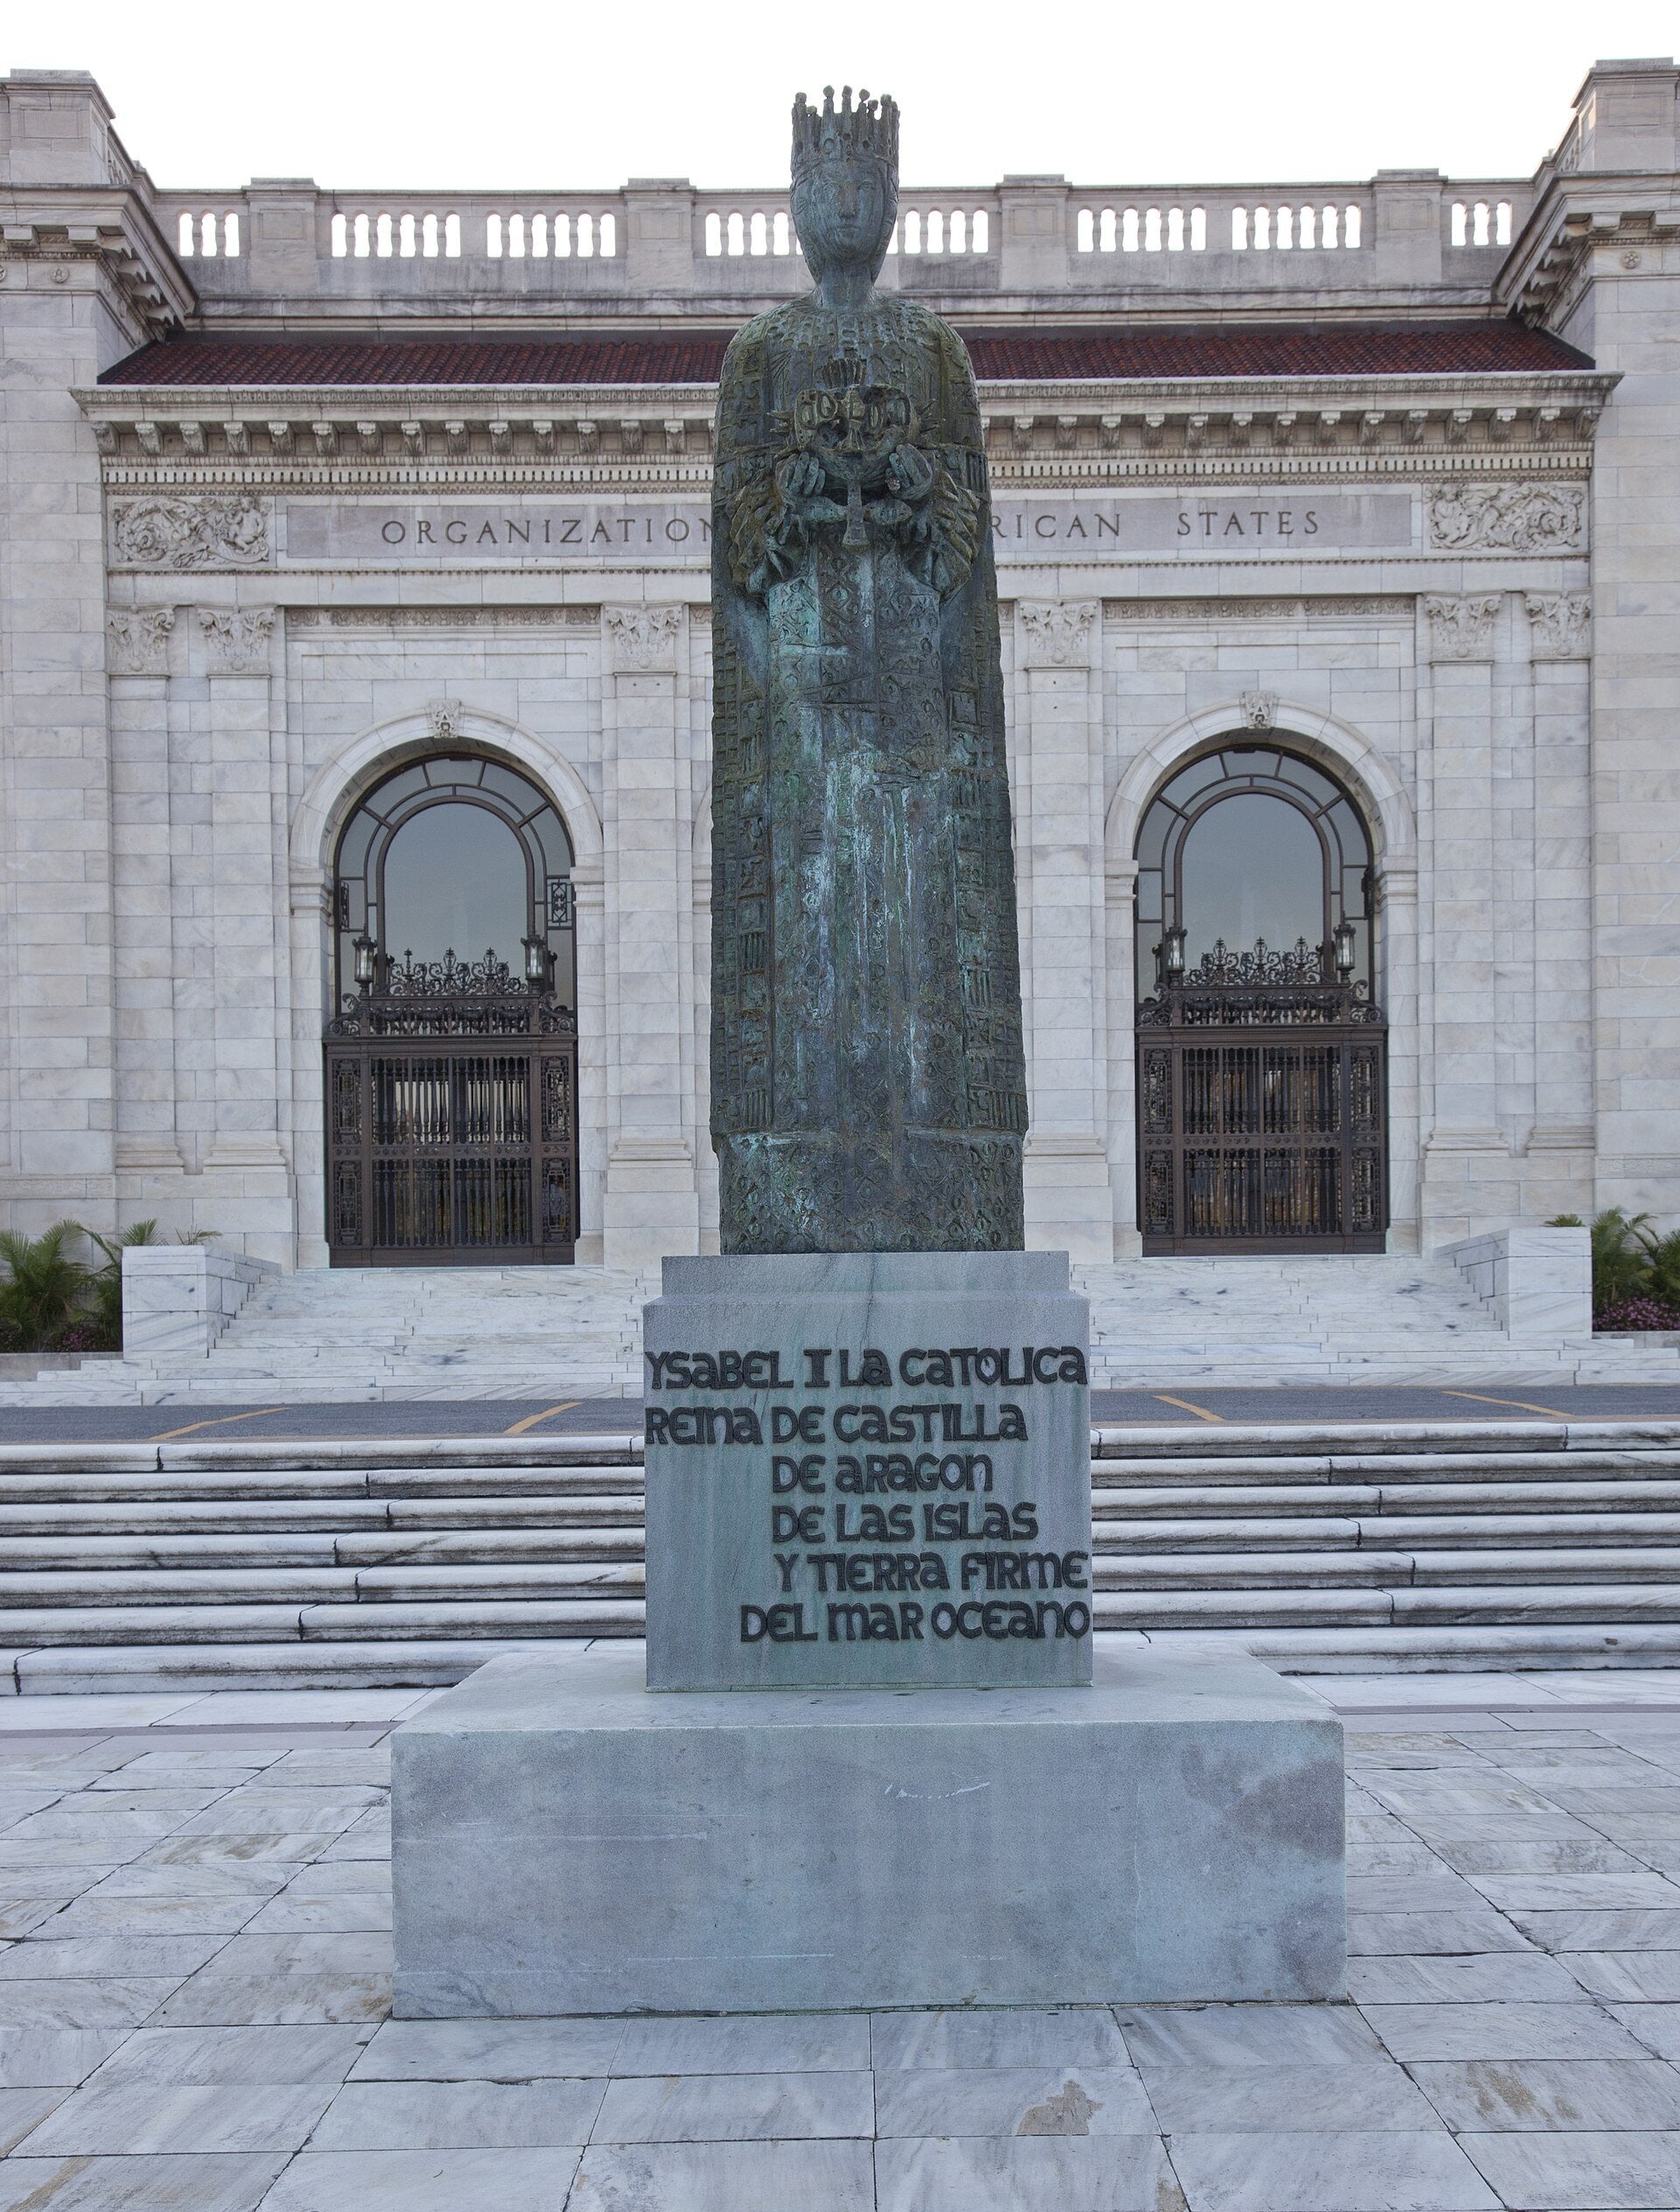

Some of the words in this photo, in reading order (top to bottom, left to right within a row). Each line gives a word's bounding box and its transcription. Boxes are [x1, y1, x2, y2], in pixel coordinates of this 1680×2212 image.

[1177, 511, 1320, 536] STATES
[803, 1349, 831, 1388] I
[774, 1554, 799, 1592] Y
